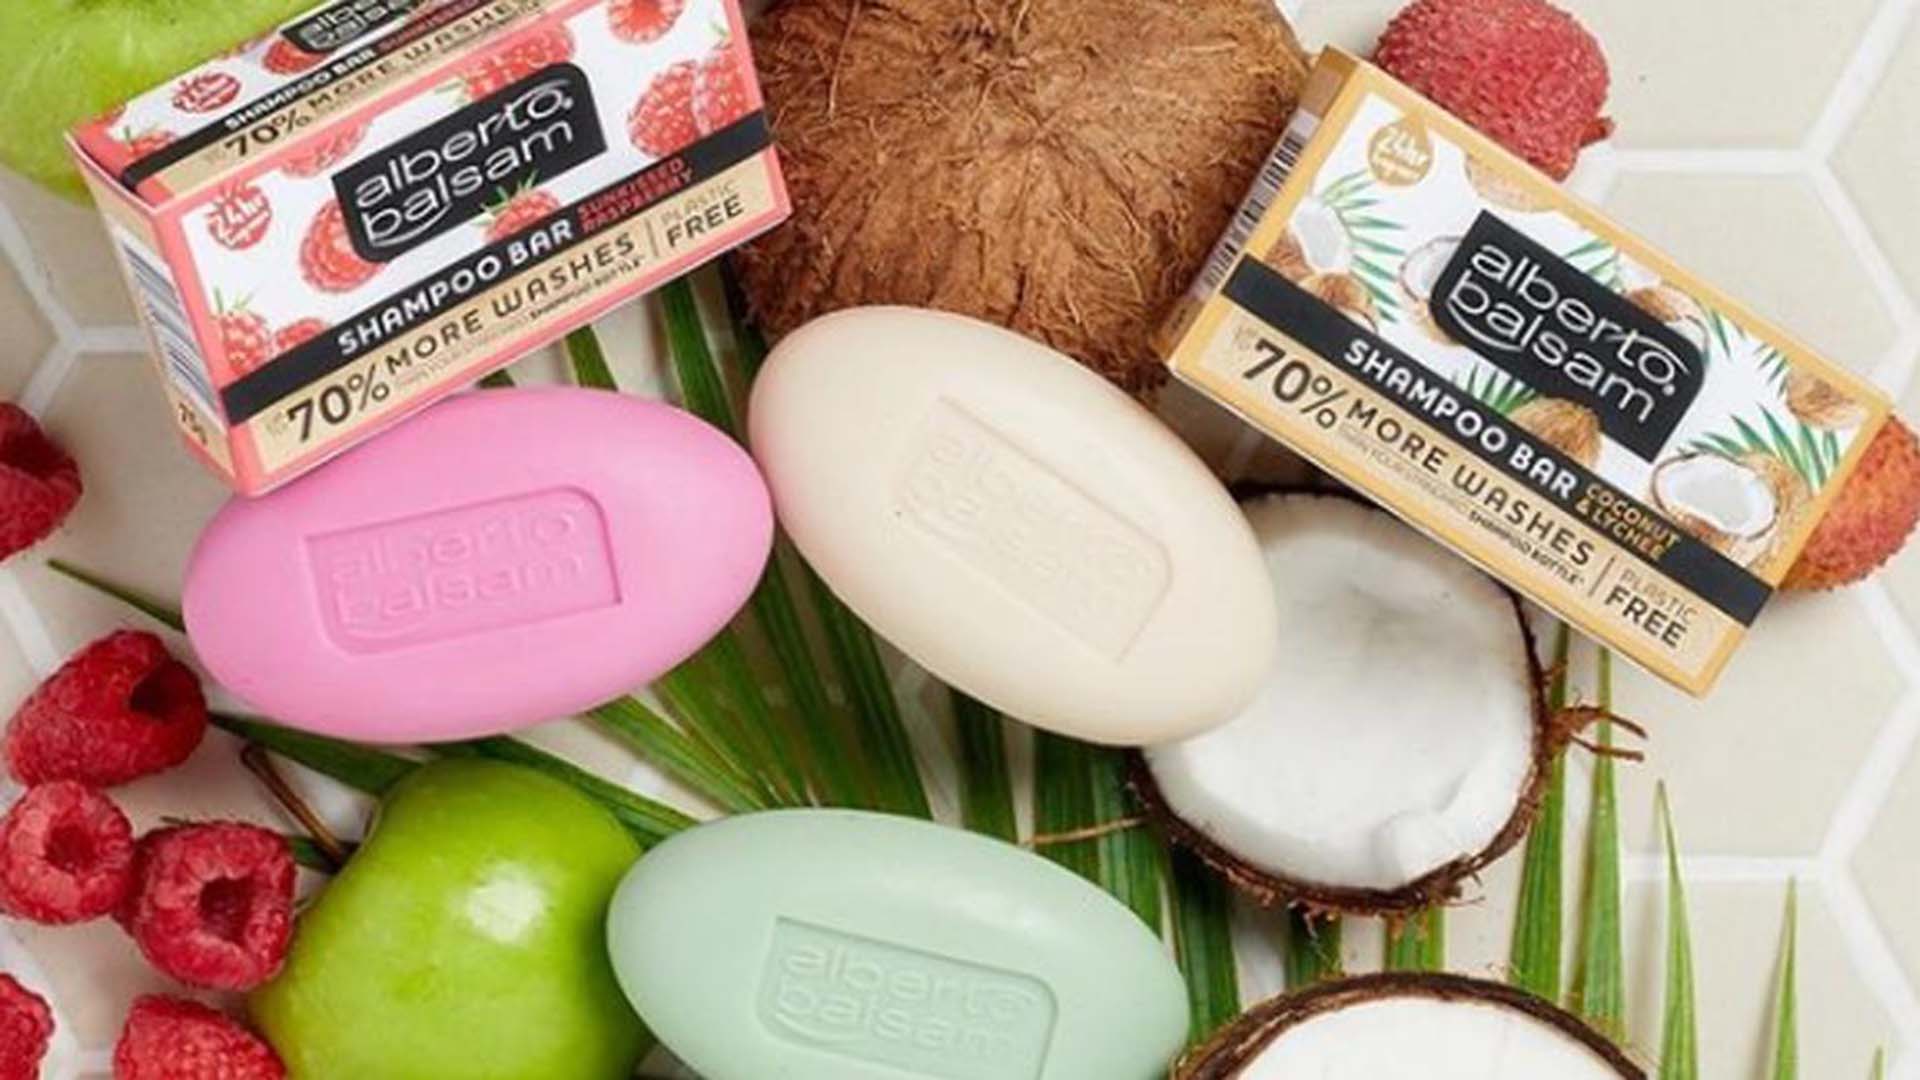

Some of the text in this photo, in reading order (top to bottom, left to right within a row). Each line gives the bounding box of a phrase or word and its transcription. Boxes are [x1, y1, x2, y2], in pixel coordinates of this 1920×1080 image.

[224, 71, 332, 130] SHAMPOO
[332, 47, 377, 74] BAR
[225, 109, 311, 156] 70%
[308, 60, 393, 107] MORE
[355, 79, 573, 208] alberto
[361, 120, 573, 246] balsam
[666, 193, 744, 249] FREE
[338, 254, 500, 356] SHAMPOO
[508, 218, 575, 266] BAR
[1470, 244, 1689, 392] alberto
[287, 361, 390, 443] 70%
[387, 310, 484, 376] MORE
[491, 231, 636, 317] WASHES
[1448, 269, 1655, 423] balsam
[1242, 338, 1348, 429] 70%
[1346, 398, 1449, 475] MORE
[1451, 464, 1596, 567] WASHES
[1343, 338, 1508, 451] SHAMPOO
[1509, 442, 1577, 500] BAR
[331, 512, 576, 583] alberto
[1574, 494, 1667, 561] & LYCHEE
[1584, 483, 1680, 548] COCONUT
[334, 554, 585, 634] balsam
[1604, 586, 1688, 649] FREE
[1620, 568, 1700, 625] PLASTIC
[776, 975, 1018, 1058] balsam
[780, 944, 1030, 1019] alberto
